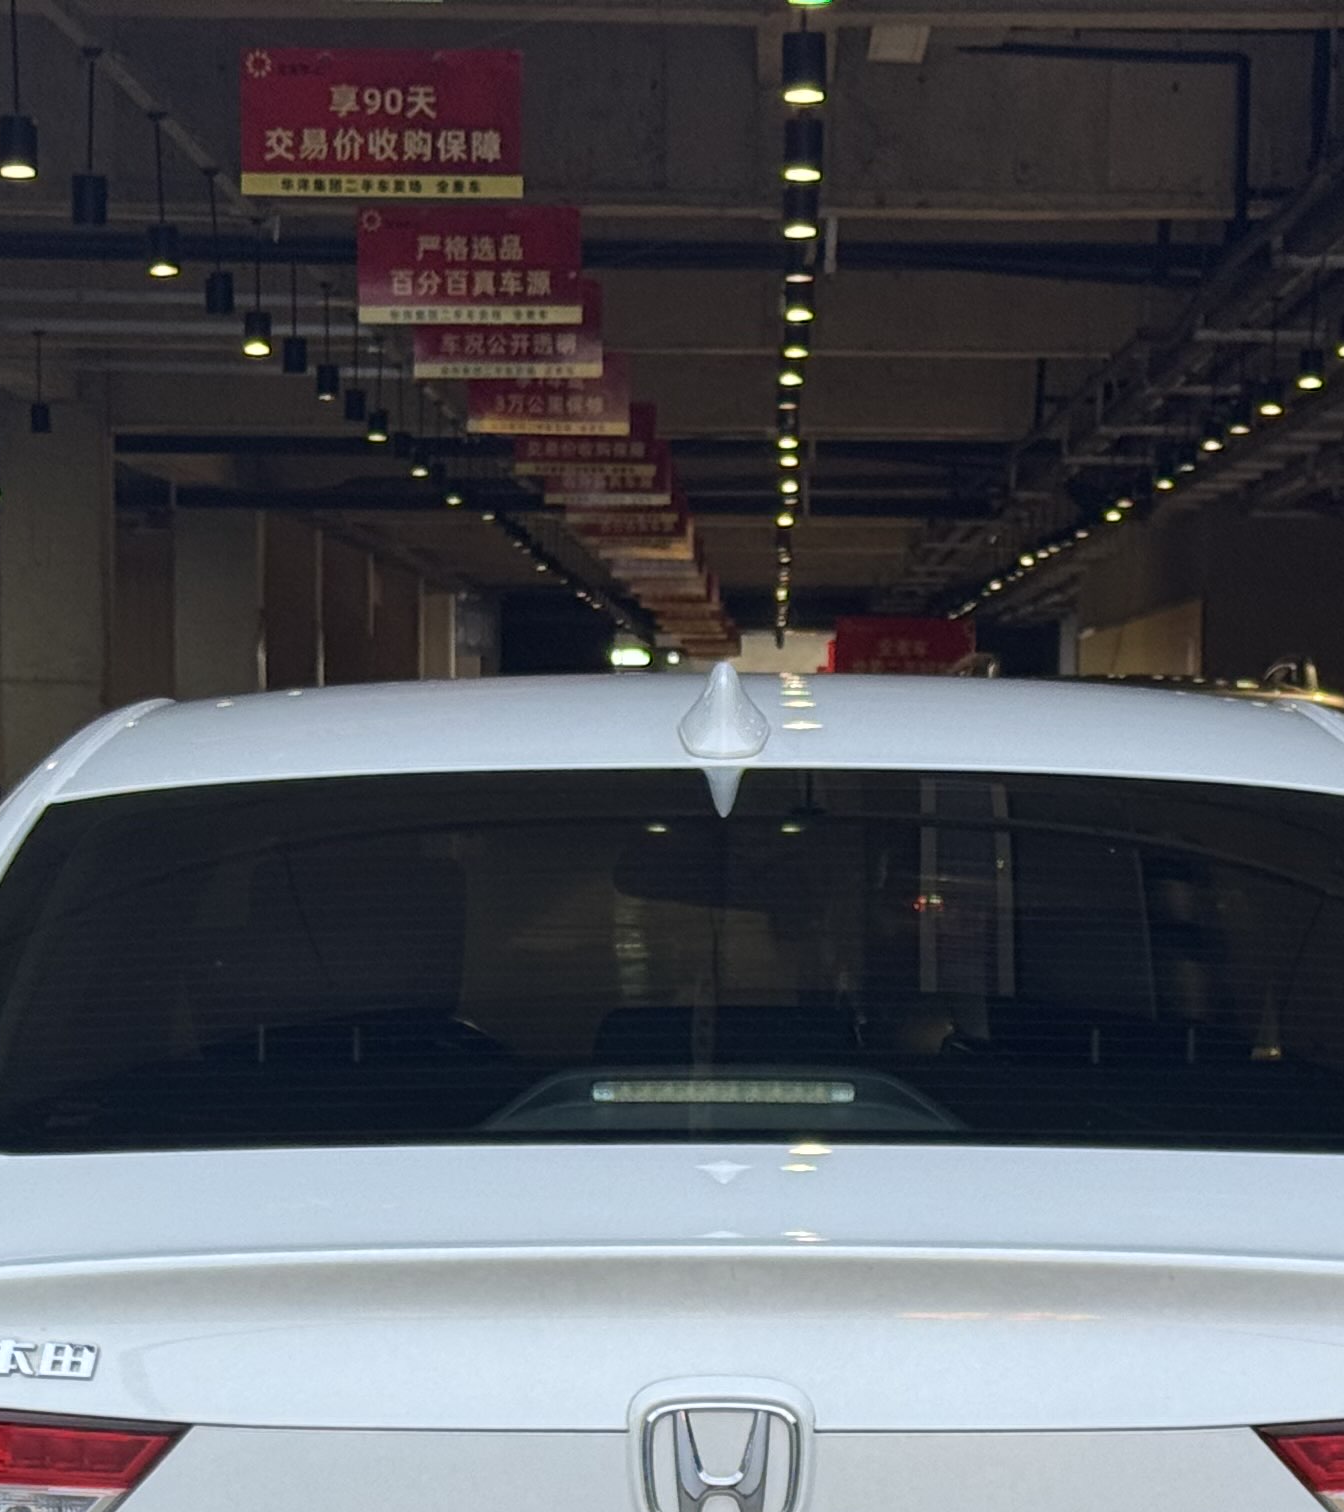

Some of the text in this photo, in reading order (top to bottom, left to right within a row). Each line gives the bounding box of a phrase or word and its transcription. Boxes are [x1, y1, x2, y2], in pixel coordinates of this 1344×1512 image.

[329, 84, 437, 119] 享90天
[264, 127, 502, 163] 交易价收购保障
[417, 234, 524, 261] 严格选品
[390, 270, 551, 296] 百分百真车源
